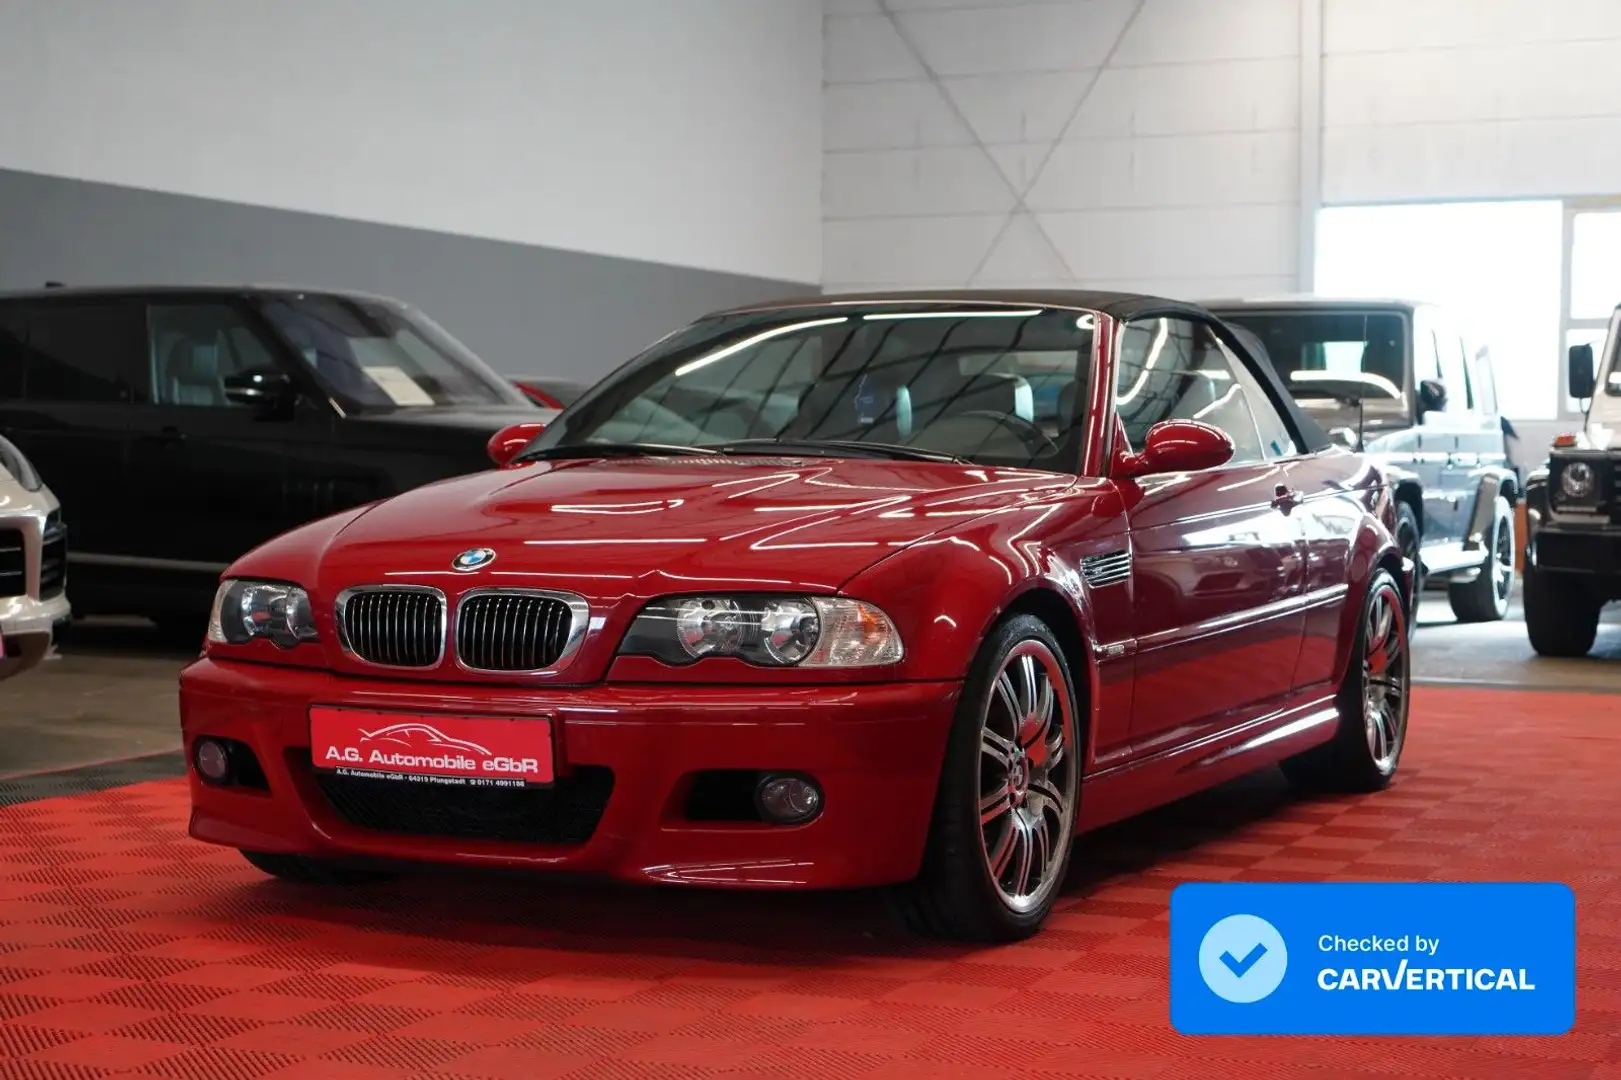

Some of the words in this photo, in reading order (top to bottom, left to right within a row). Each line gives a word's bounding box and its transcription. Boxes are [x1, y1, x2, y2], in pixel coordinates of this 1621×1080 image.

[325, 746, 363, 762] A.G.
[369, 750, 476, 770] Automobile
[482, 757, 538, 773] eGbR
[351, 770, 385, 779] Automobile
